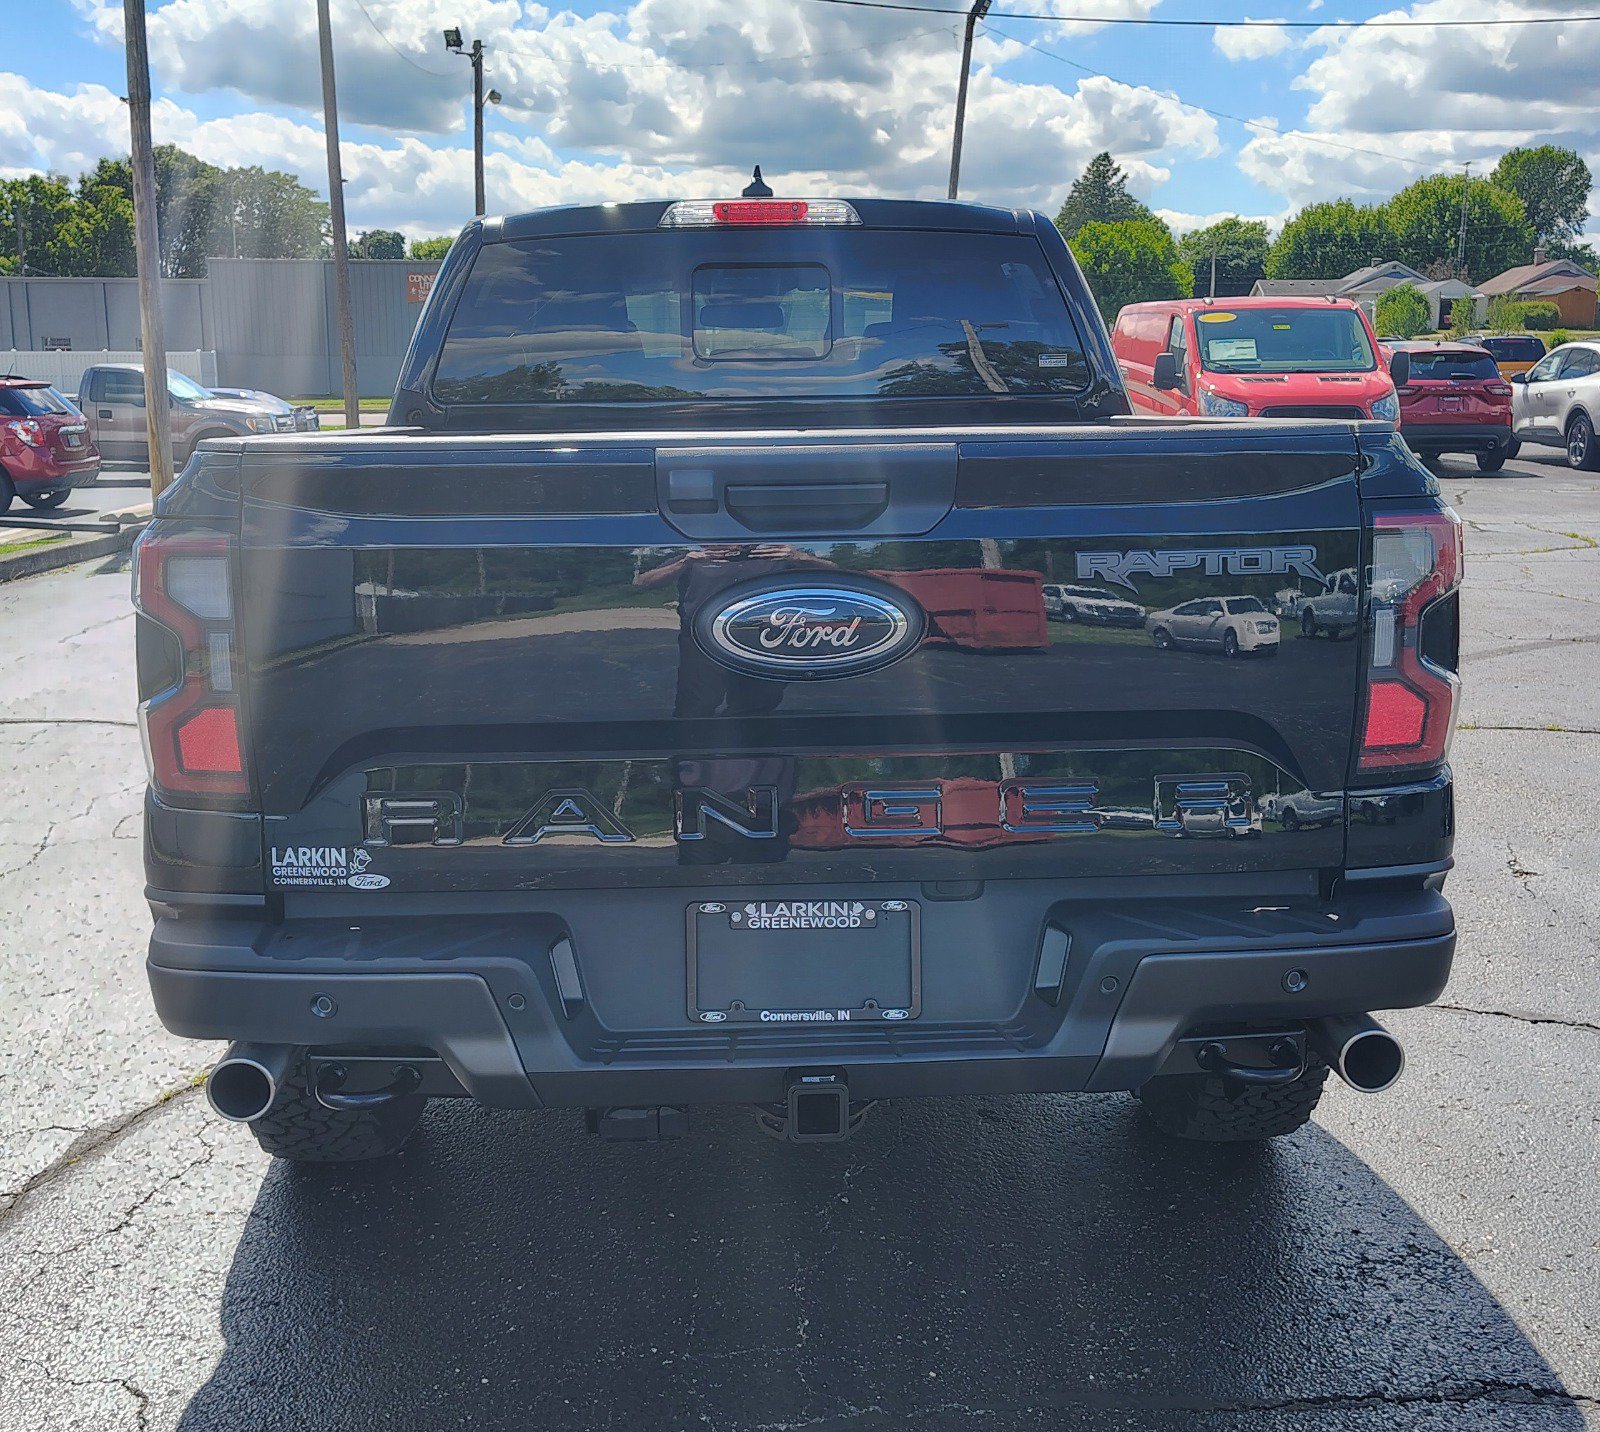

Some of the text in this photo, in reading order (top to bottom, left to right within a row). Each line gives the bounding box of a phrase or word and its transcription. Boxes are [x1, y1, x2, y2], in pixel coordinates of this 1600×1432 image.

[1075, 544, 1329, 594] RAPTOR
[759, 605, 862, 649] Ford
[361, 772, 1253, 847] RANGER
[271, 847, 347, 867] LARKIN
[272, 867, 347, 877] GREENEWOOD
[273, 877, 347, 886] CONNERSVILLE, IN
[354, 875, 384, 888] Ford
[760, 901, 848, 917] LARKIN
[747, 917, 861, 929] GREENEWOOD
[760, 1009, 850, 1022] Connersville, IN
